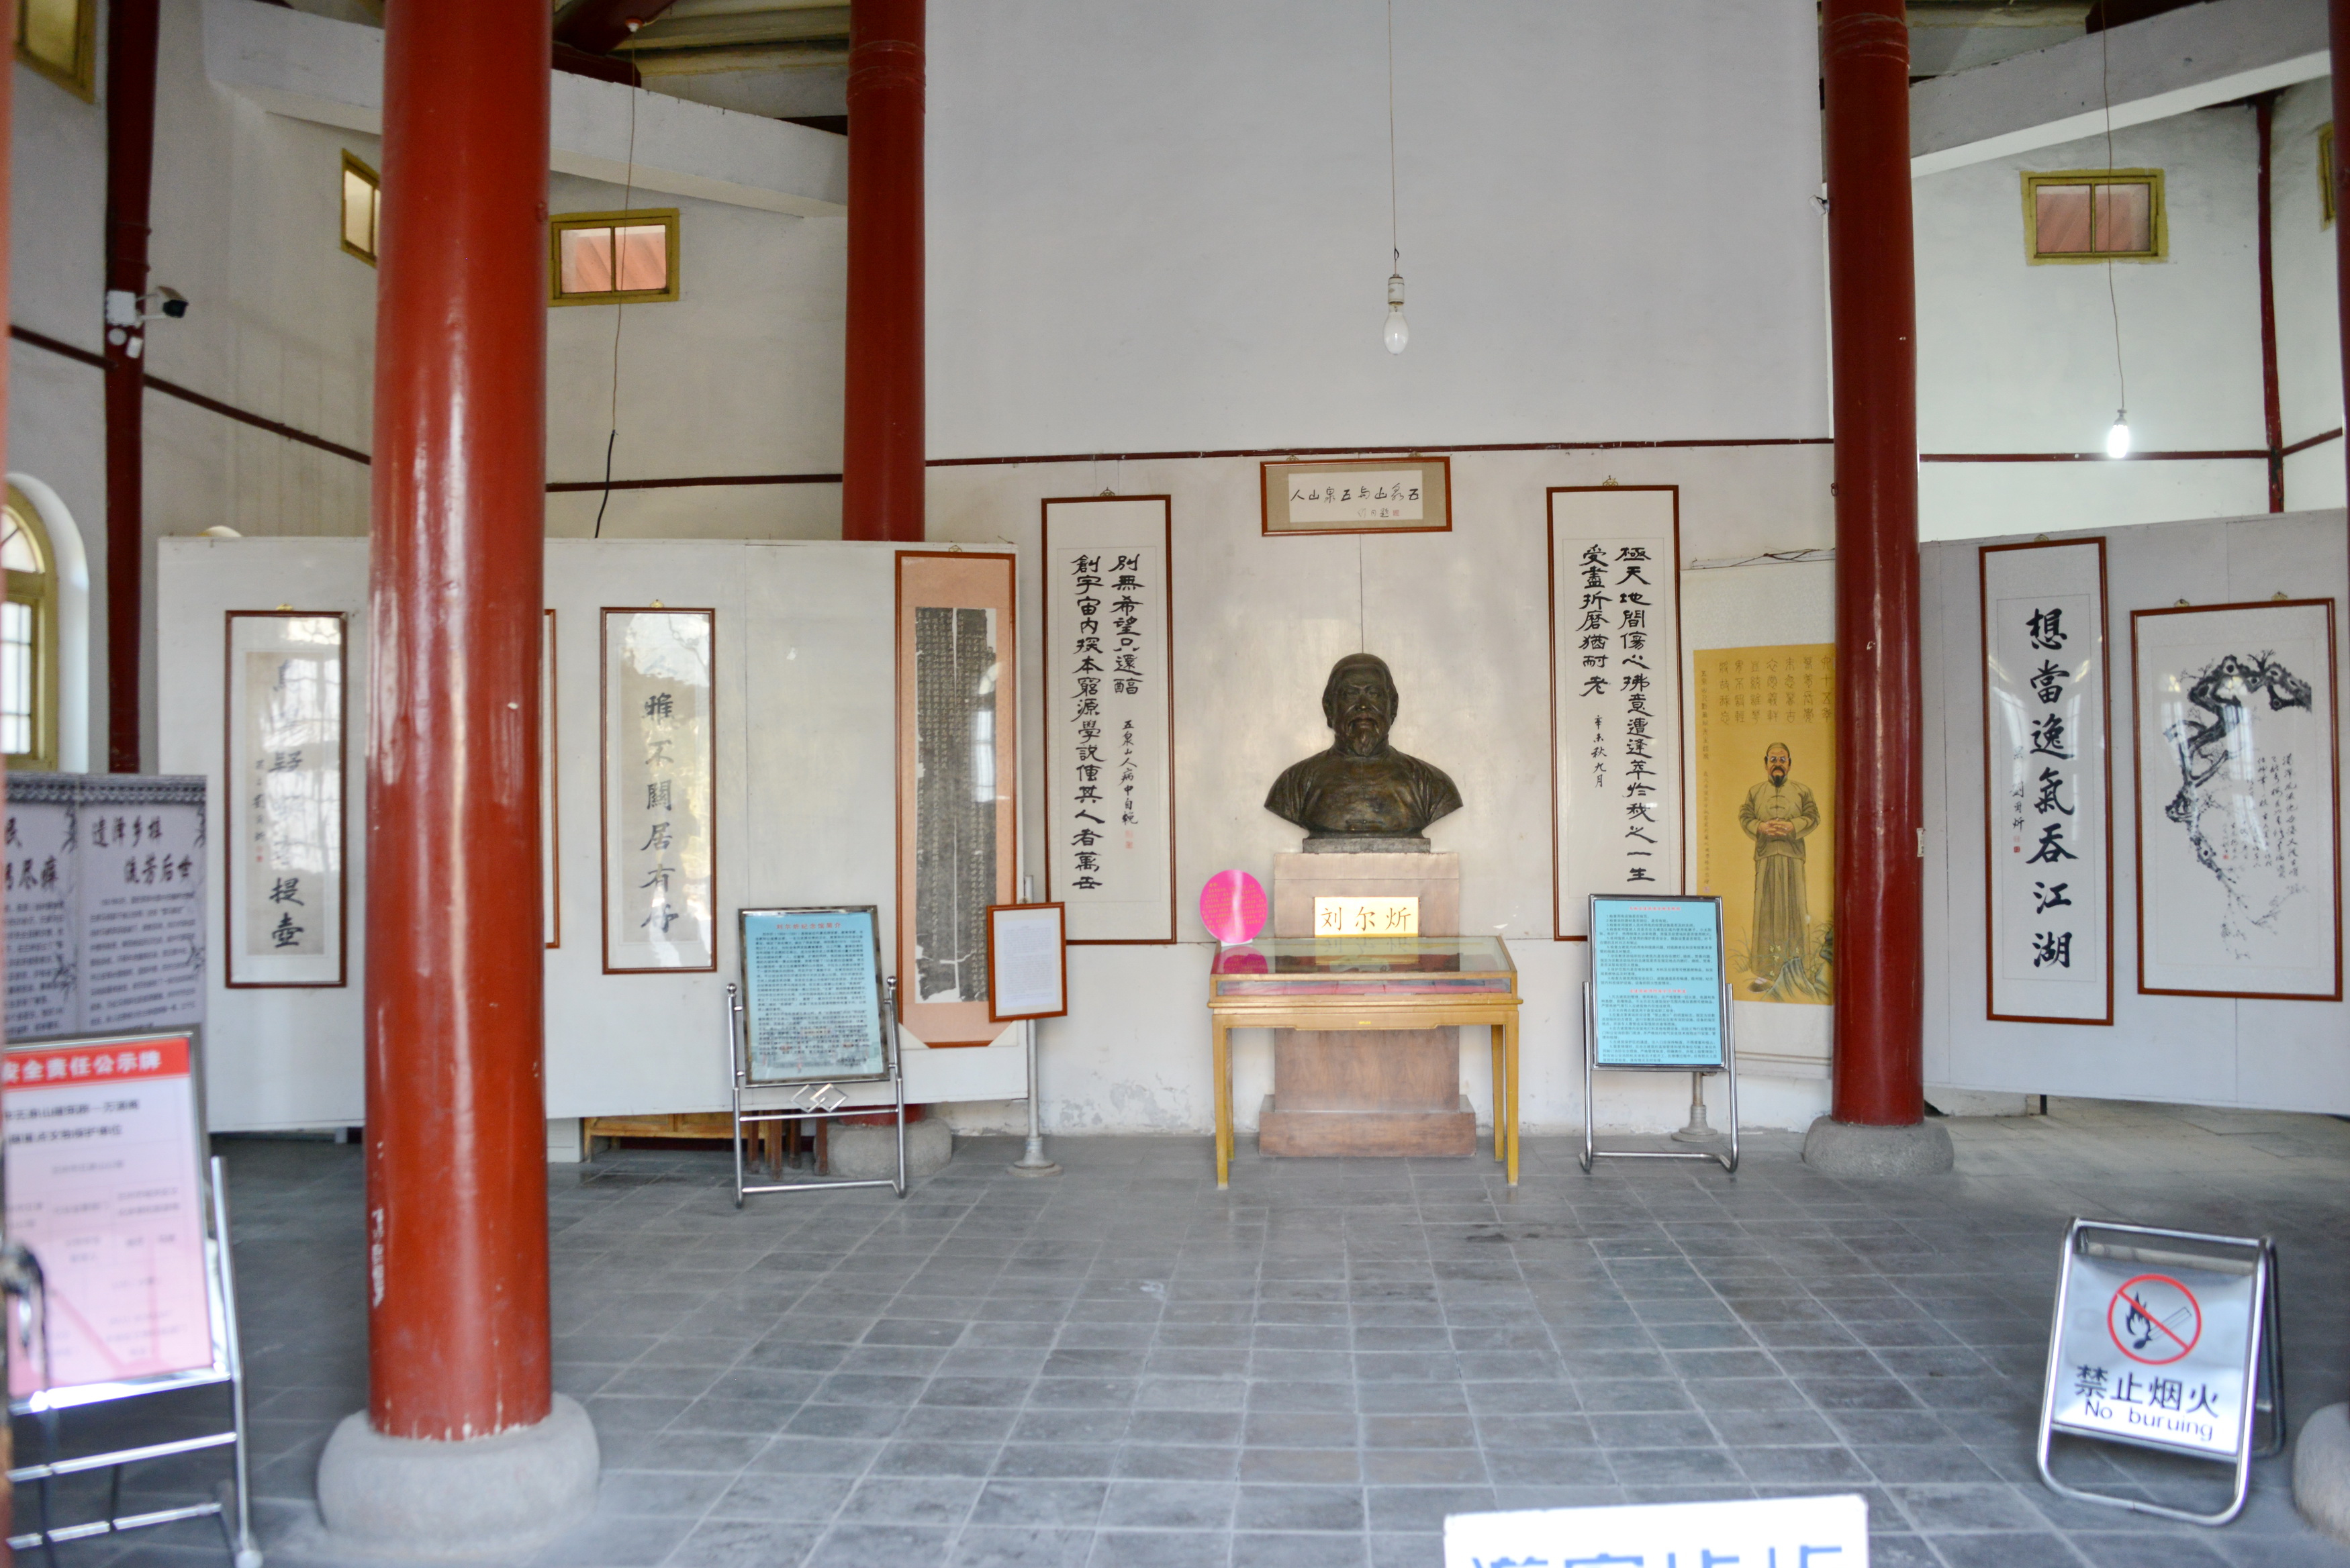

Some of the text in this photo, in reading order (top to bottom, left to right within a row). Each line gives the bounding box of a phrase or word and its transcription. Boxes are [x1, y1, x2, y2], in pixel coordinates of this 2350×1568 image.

[2025, 607, 2079, 968] 想當逸氣吞江湖
[1321, 906, 1411, 932] 刘尔炘
[2075, 1364, 2220, 1419] 禁止烟火
[2084, 1400, 2113, 1420] No
